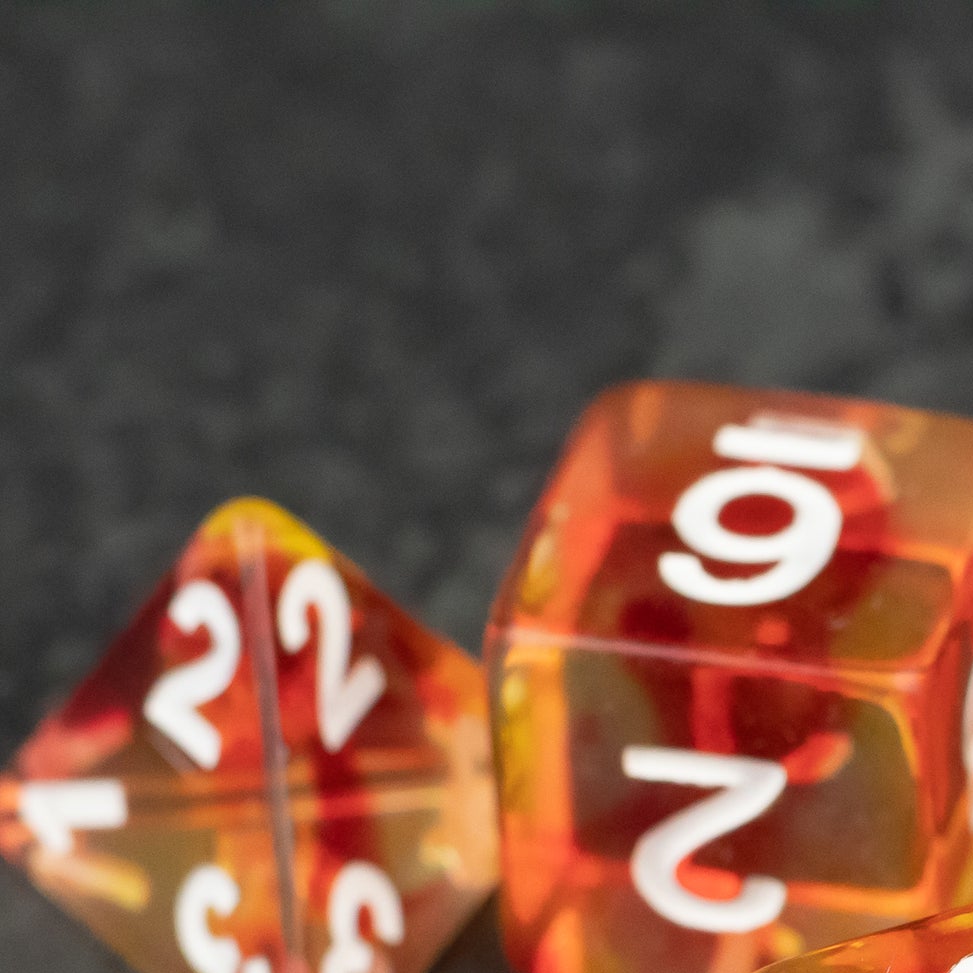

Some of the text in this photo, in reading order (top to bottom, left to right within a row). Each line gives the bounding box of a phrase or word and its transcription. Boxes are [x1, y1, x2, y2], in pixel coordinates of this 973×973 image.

[144, 579, 240, 769] 2
[278, 558, 386, 753] 2
[20, 779, 127, 853] 1
[622, 745, 786, 934] 2
